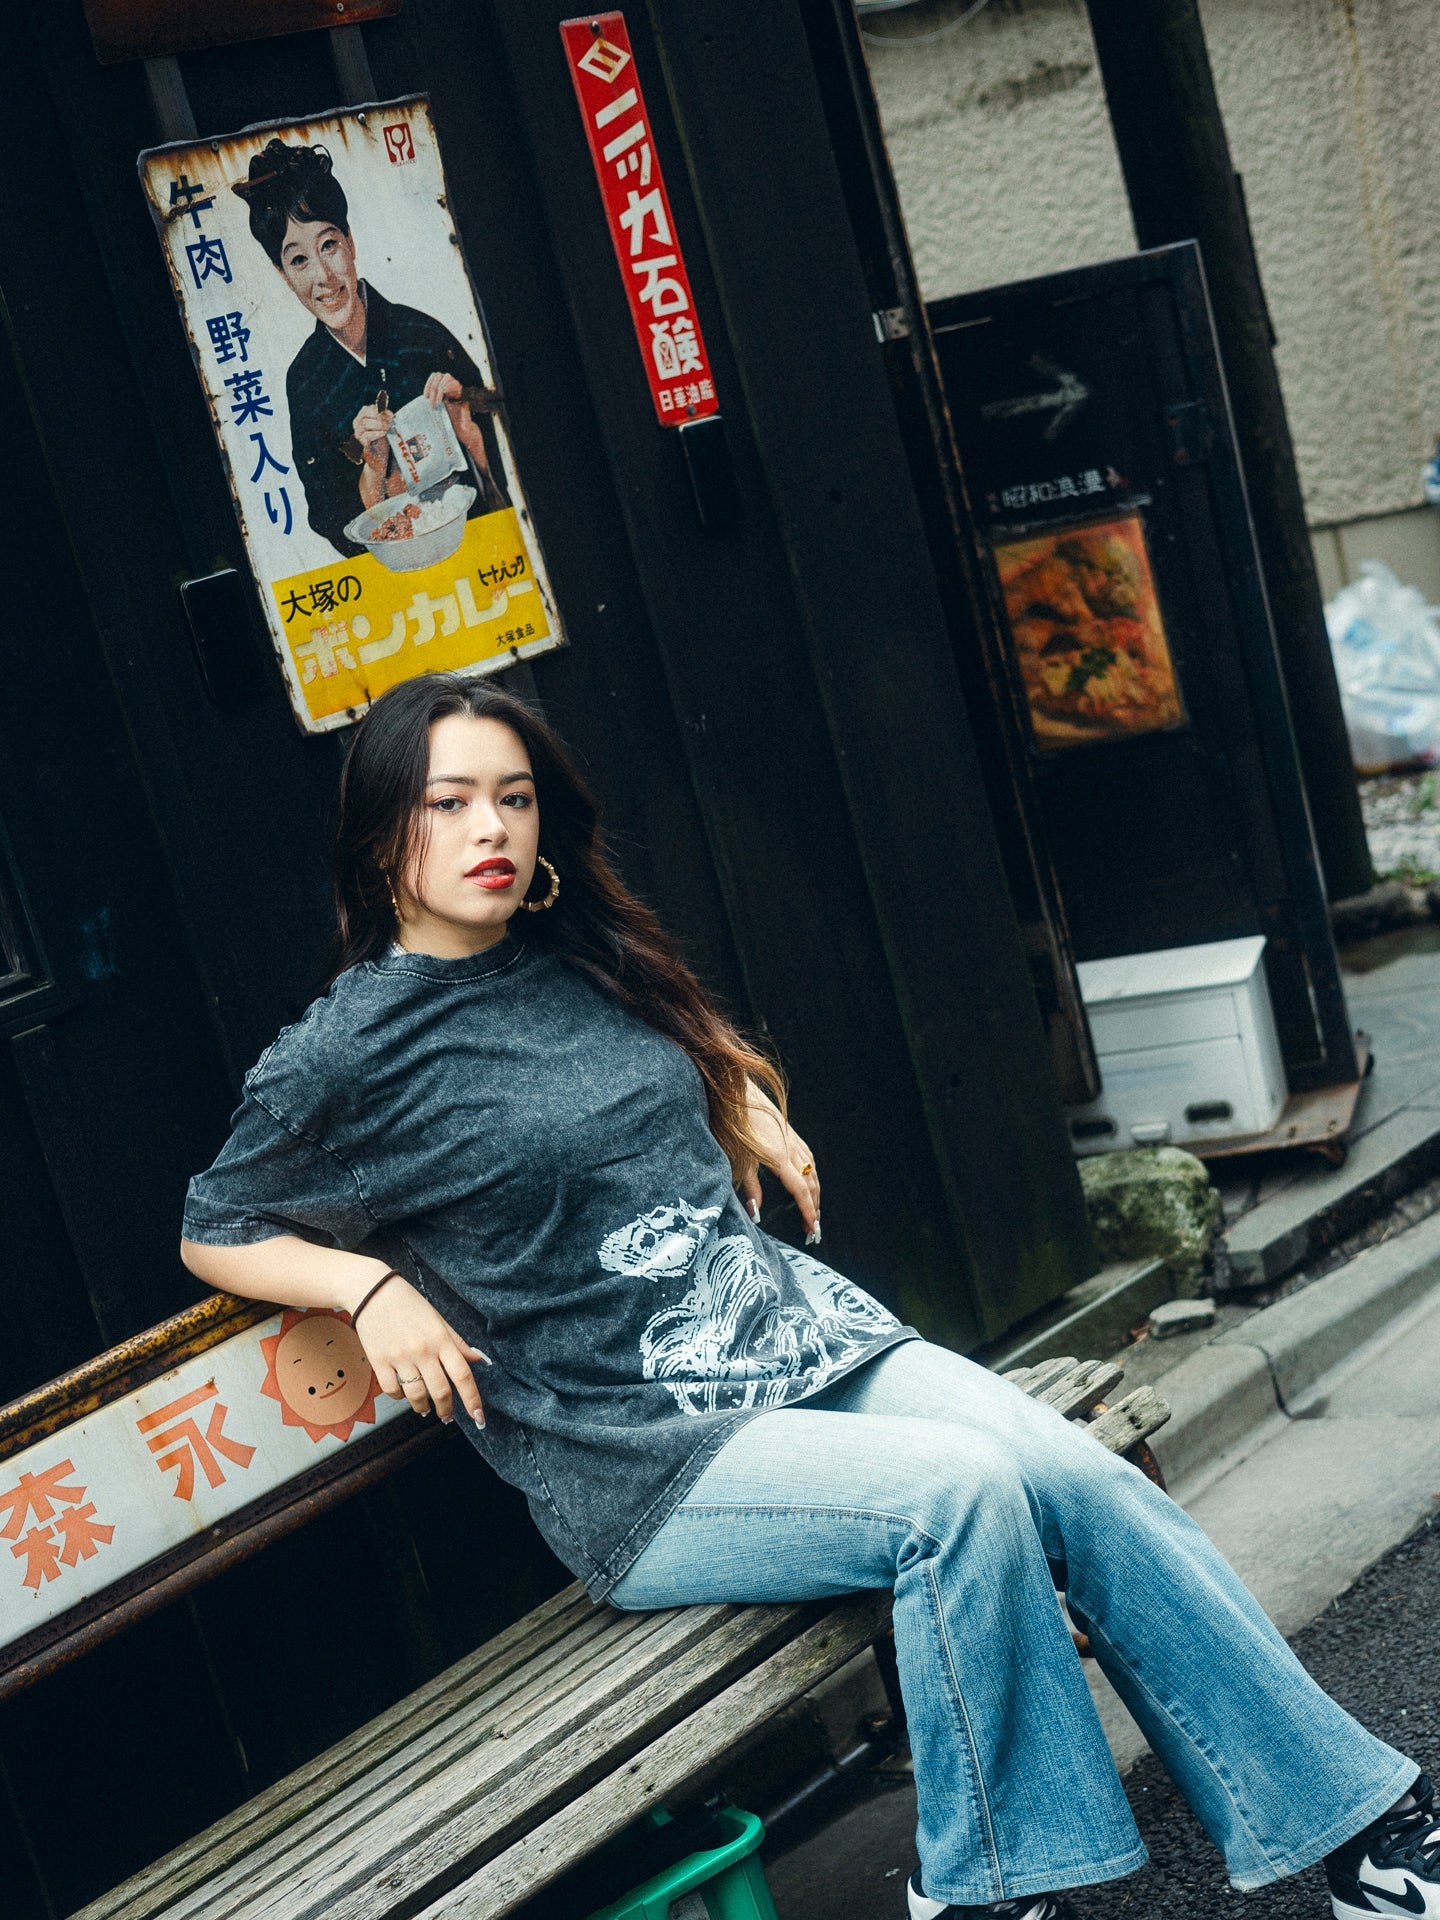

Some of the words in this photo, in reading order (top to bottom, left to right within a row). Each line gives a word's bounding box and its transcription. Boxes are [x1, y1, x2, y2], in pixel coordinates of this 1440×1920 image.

[595, 87, 704, 380] ニッカ石鹸
[170, 175, 232, 289] 牛肉
[206, 311, 292, 535] 野菜入り
[281, 575, 362, 623] 大塚の
[478, 555, 525, 587] ヒートパック
[295, 577, 534, 685] ボンカレー
[496, 623, 536, 647] 大塚食品
[0, 1382, 257, 1591] 森永
